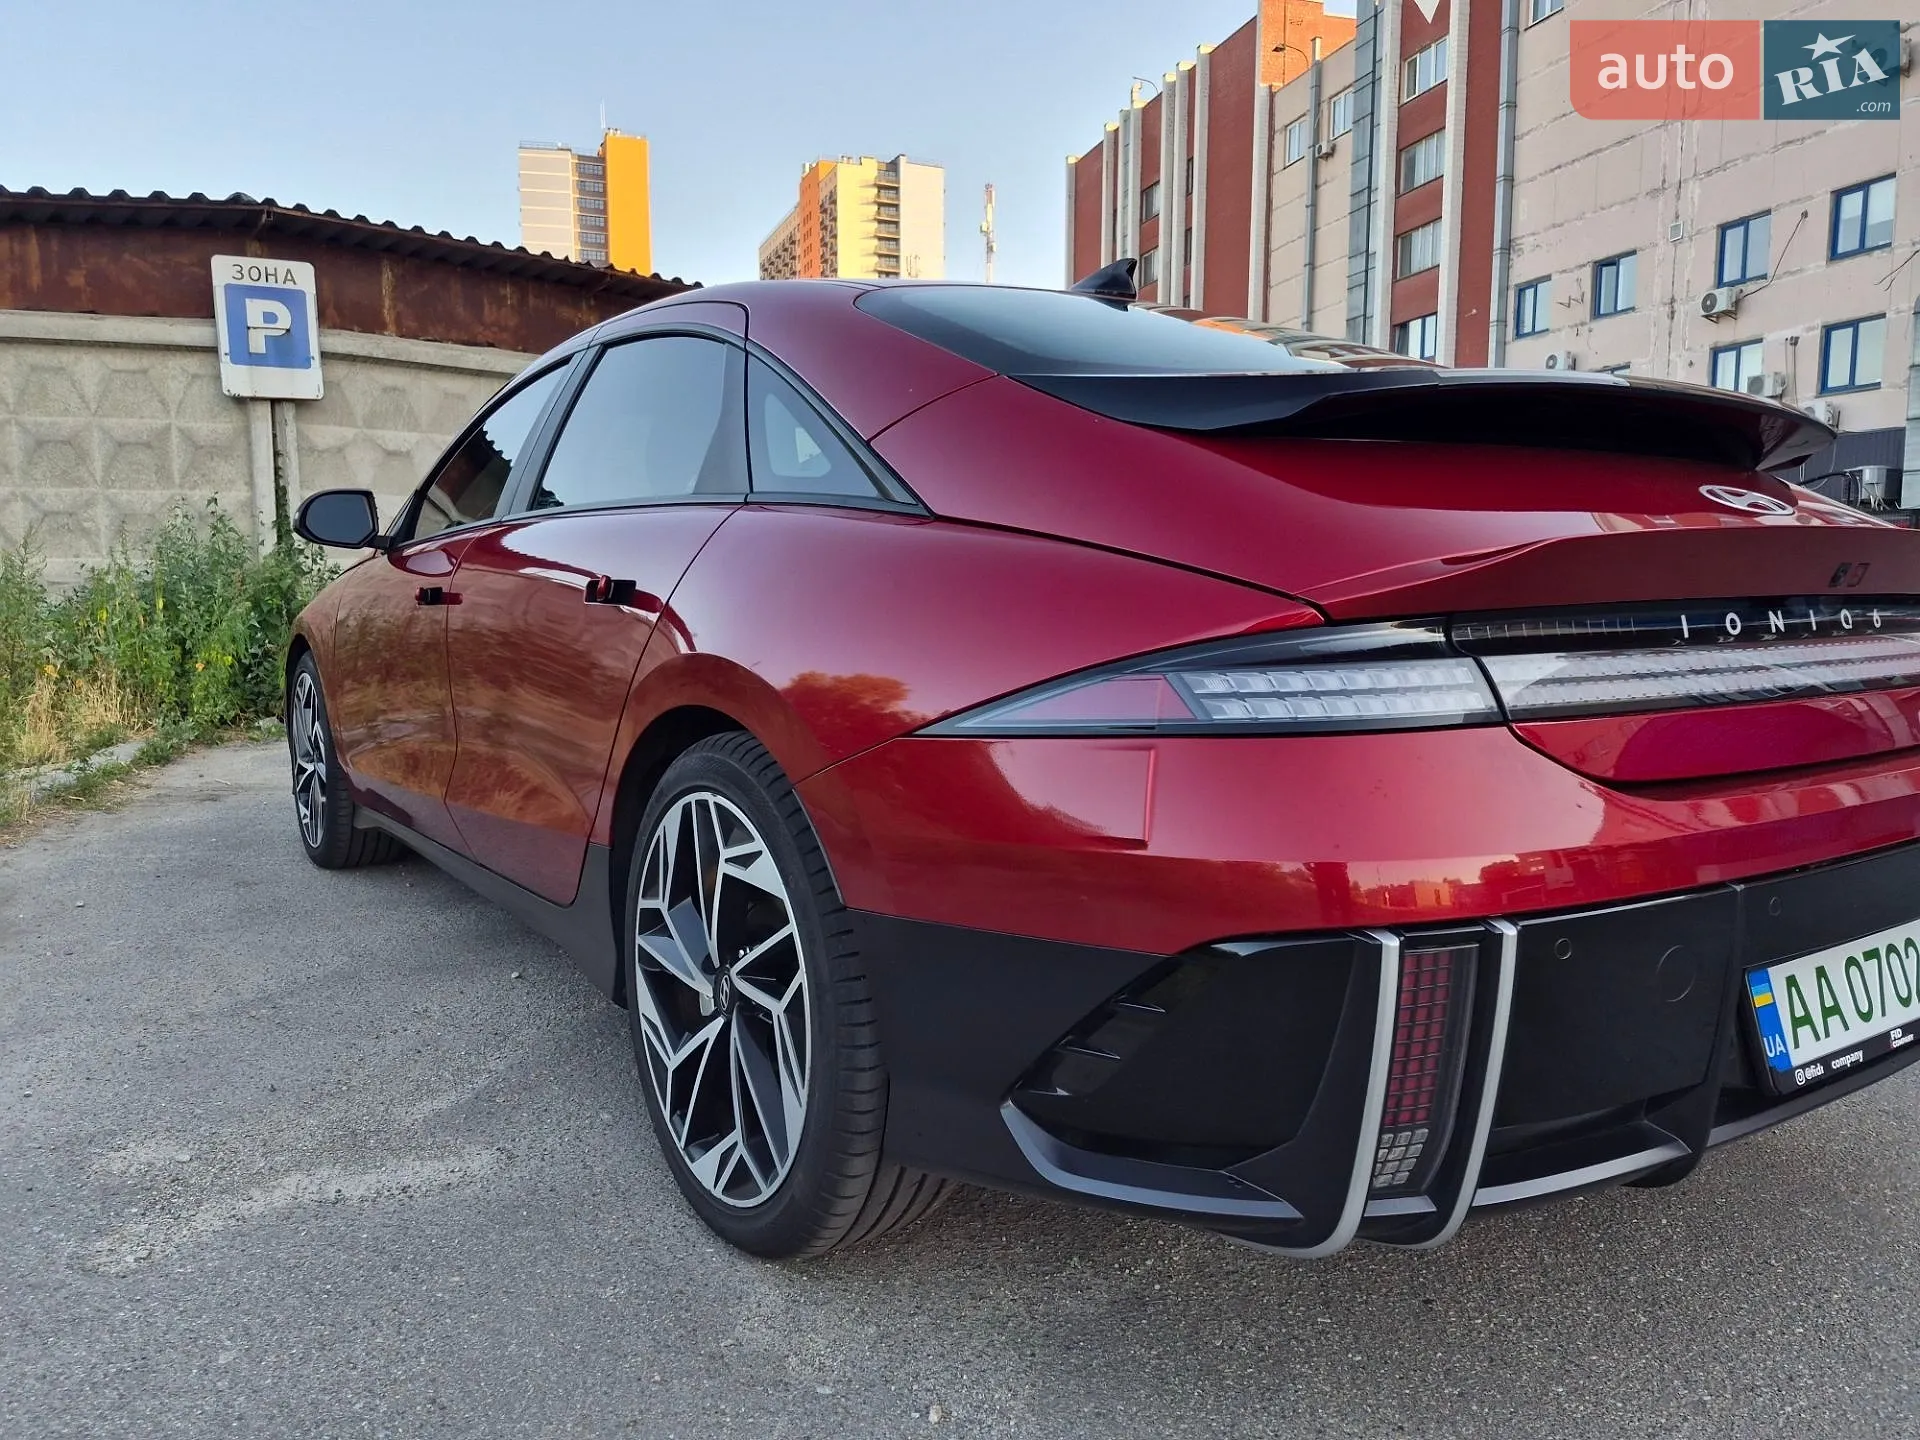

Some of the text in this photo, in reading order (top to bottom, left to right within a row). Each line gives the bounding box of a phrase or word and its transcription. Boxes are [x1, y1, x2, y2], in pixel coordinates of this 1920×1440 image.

[231, 263, 298, 286] ЗОНА
[245, 297, 292, 354] P
[1762, 1033, 1787, 1058] UA
[1831, 1049, 1864, 1069] company
